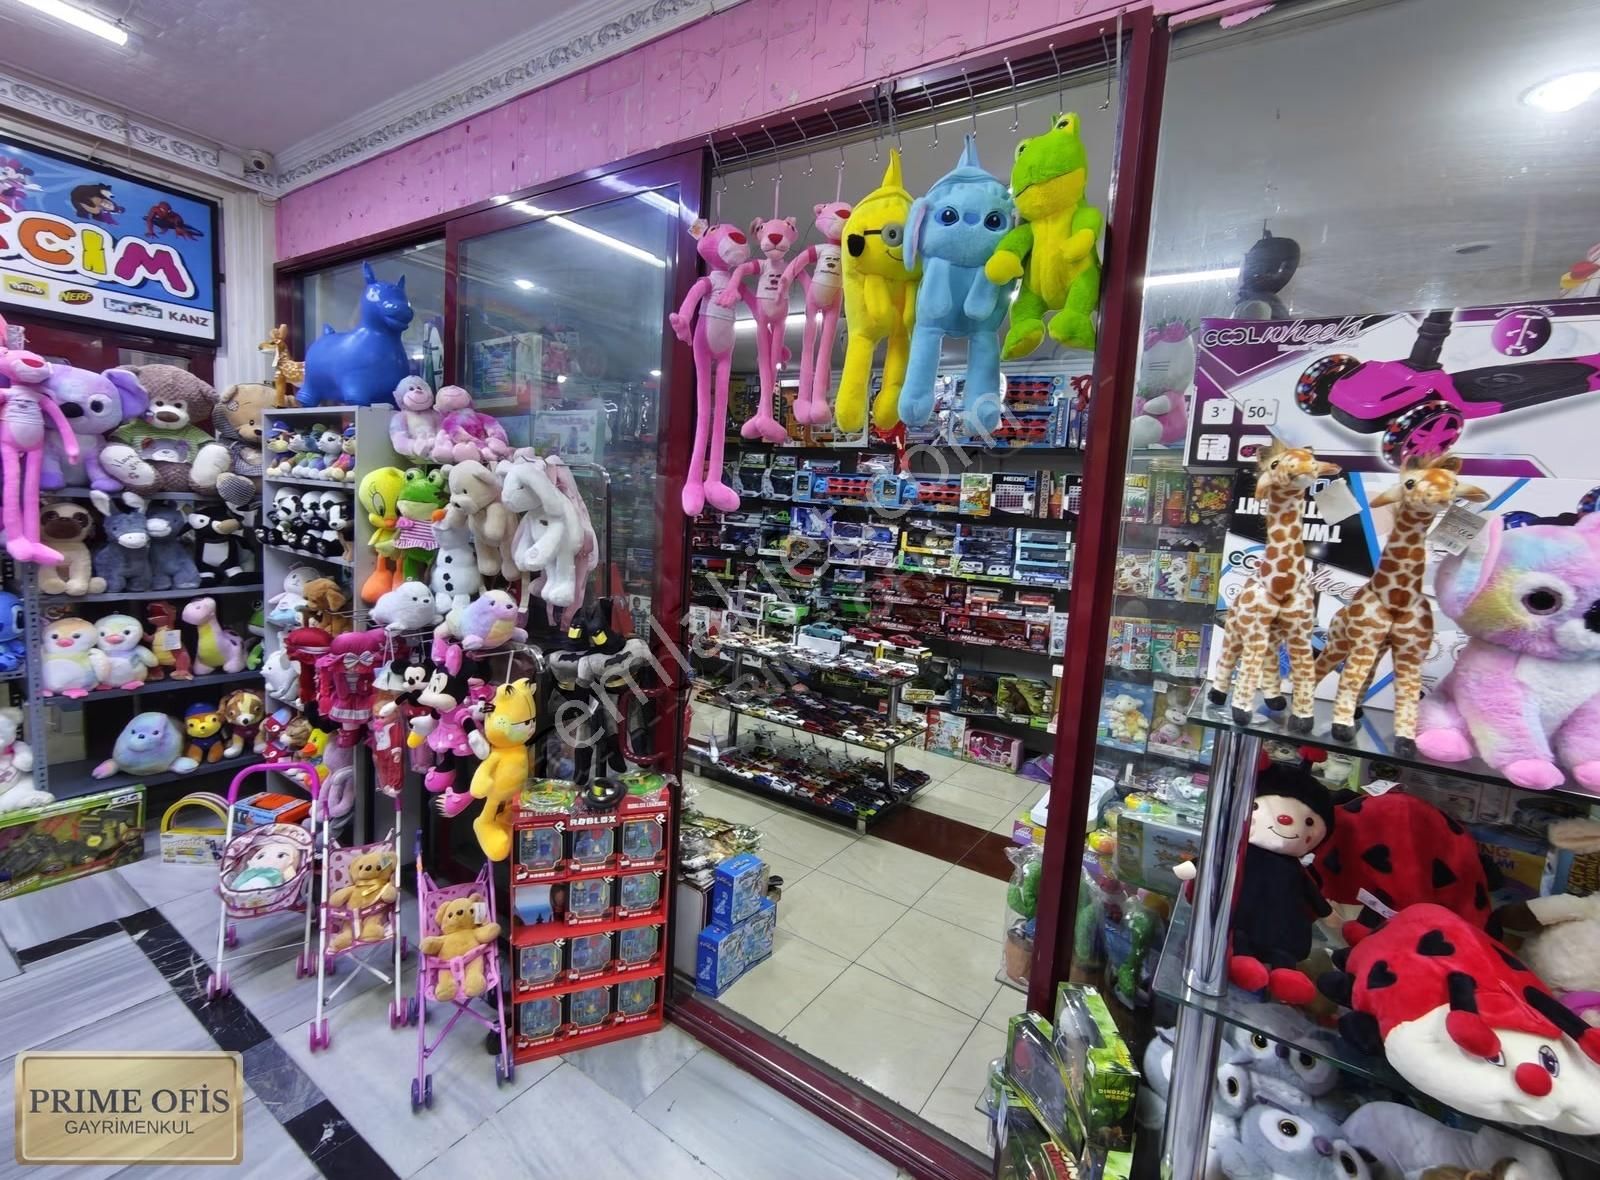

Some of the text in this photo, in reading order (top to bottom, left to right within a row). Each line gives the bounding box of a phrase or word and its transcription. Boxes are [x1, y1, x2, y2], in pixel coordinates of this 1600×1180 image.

[58, 291, 92, 303] NERF
[168, 311, 209, 327] KANZ
[1303, 523, 1342, 543] TWI
[570, 815, 617, 826] ROBLOX
